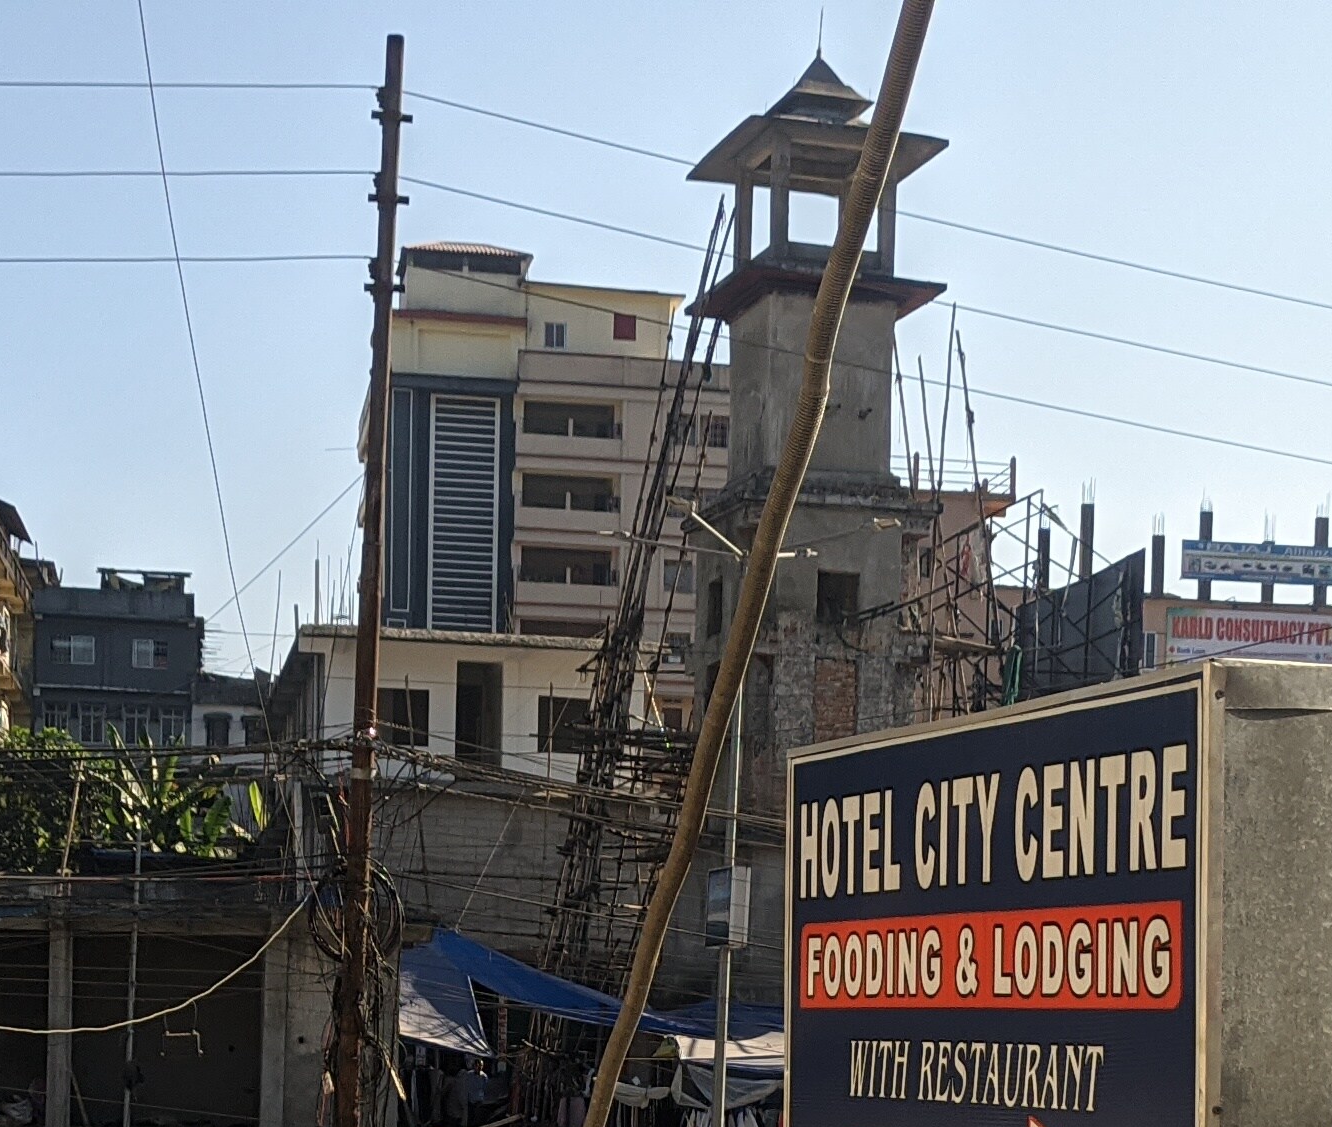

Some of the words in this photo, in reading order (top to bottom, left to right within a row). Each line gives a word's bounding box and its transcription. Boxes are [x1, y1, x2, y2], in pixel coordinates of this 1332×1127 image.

[1282, 546, 1331, 557] Allianz
[1217, 617, 1305, 645] CONSULTANCY
[799, 789, 901, 898] HOTEL
[913, 772, 1001, 890] CITY
[1014, 744, 1188, 882] CENTRE
[806, 927, 942, 998] FOODING
[954, 925, 979, 995] &
[992, 917, 1171, 997] LODGING
[849, 1040, 911, 1099] WITH
[917, 1041, 1105, 1112] RESTAURANT
